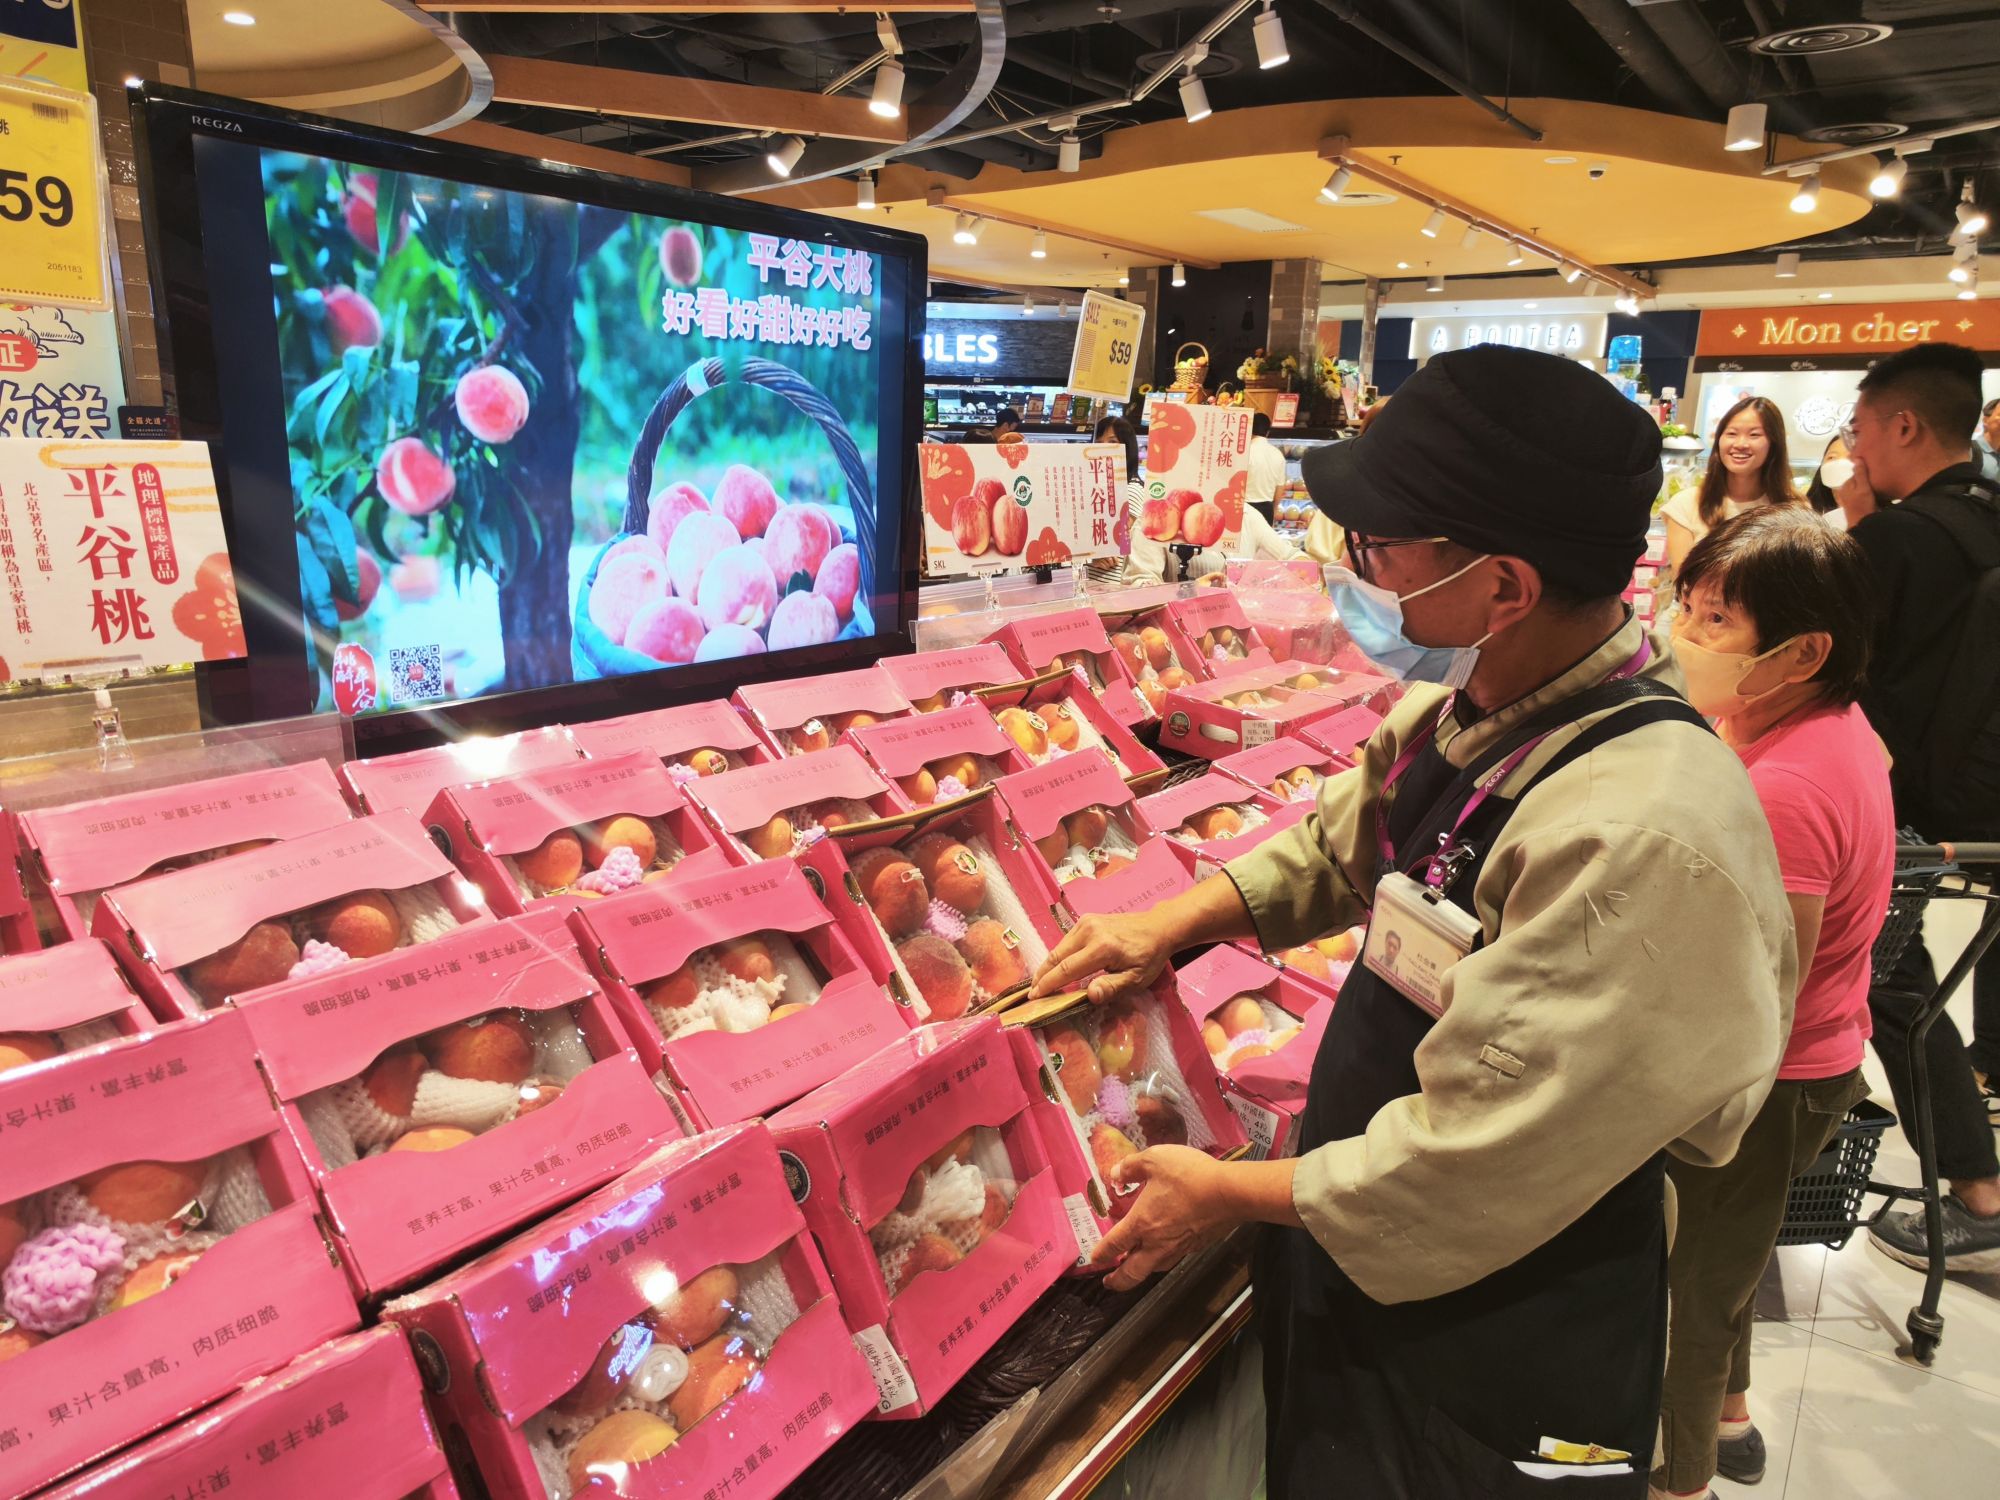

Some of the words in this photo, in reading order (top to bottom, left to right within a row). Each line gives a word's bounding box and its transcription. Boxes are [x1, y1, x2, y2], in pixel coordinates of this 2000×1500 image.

[192, 115, 243, 133] REGZA
[747, 233, 873, 296] 平谷大桃
[661, 287, 873, 350] 好看好甜好好吃
[1760, 317, 1841, 345] Mon
[1851, 312, 1939, 343] cher
[1109, 338, 1132, 365] $59
[1216, 412, 1237, 468] 平谷桃
[137, 469, 176, 580] 地理標誌產品
[1088, 456, 1109, 547] 平谷桃
[61, 463, 156, 645] 平谷桃
[933, 559, 947, 569] SKL
[1223, 541, 1237, 549] SKL
[0, 1057, 189, 1133] 营养丰富，果汁含
[407, 1121, 633, 1236] 营养丰富，果汁含量高，肉质细脆
[163, 1401, 349, 1500] 营养丰富，果汁
